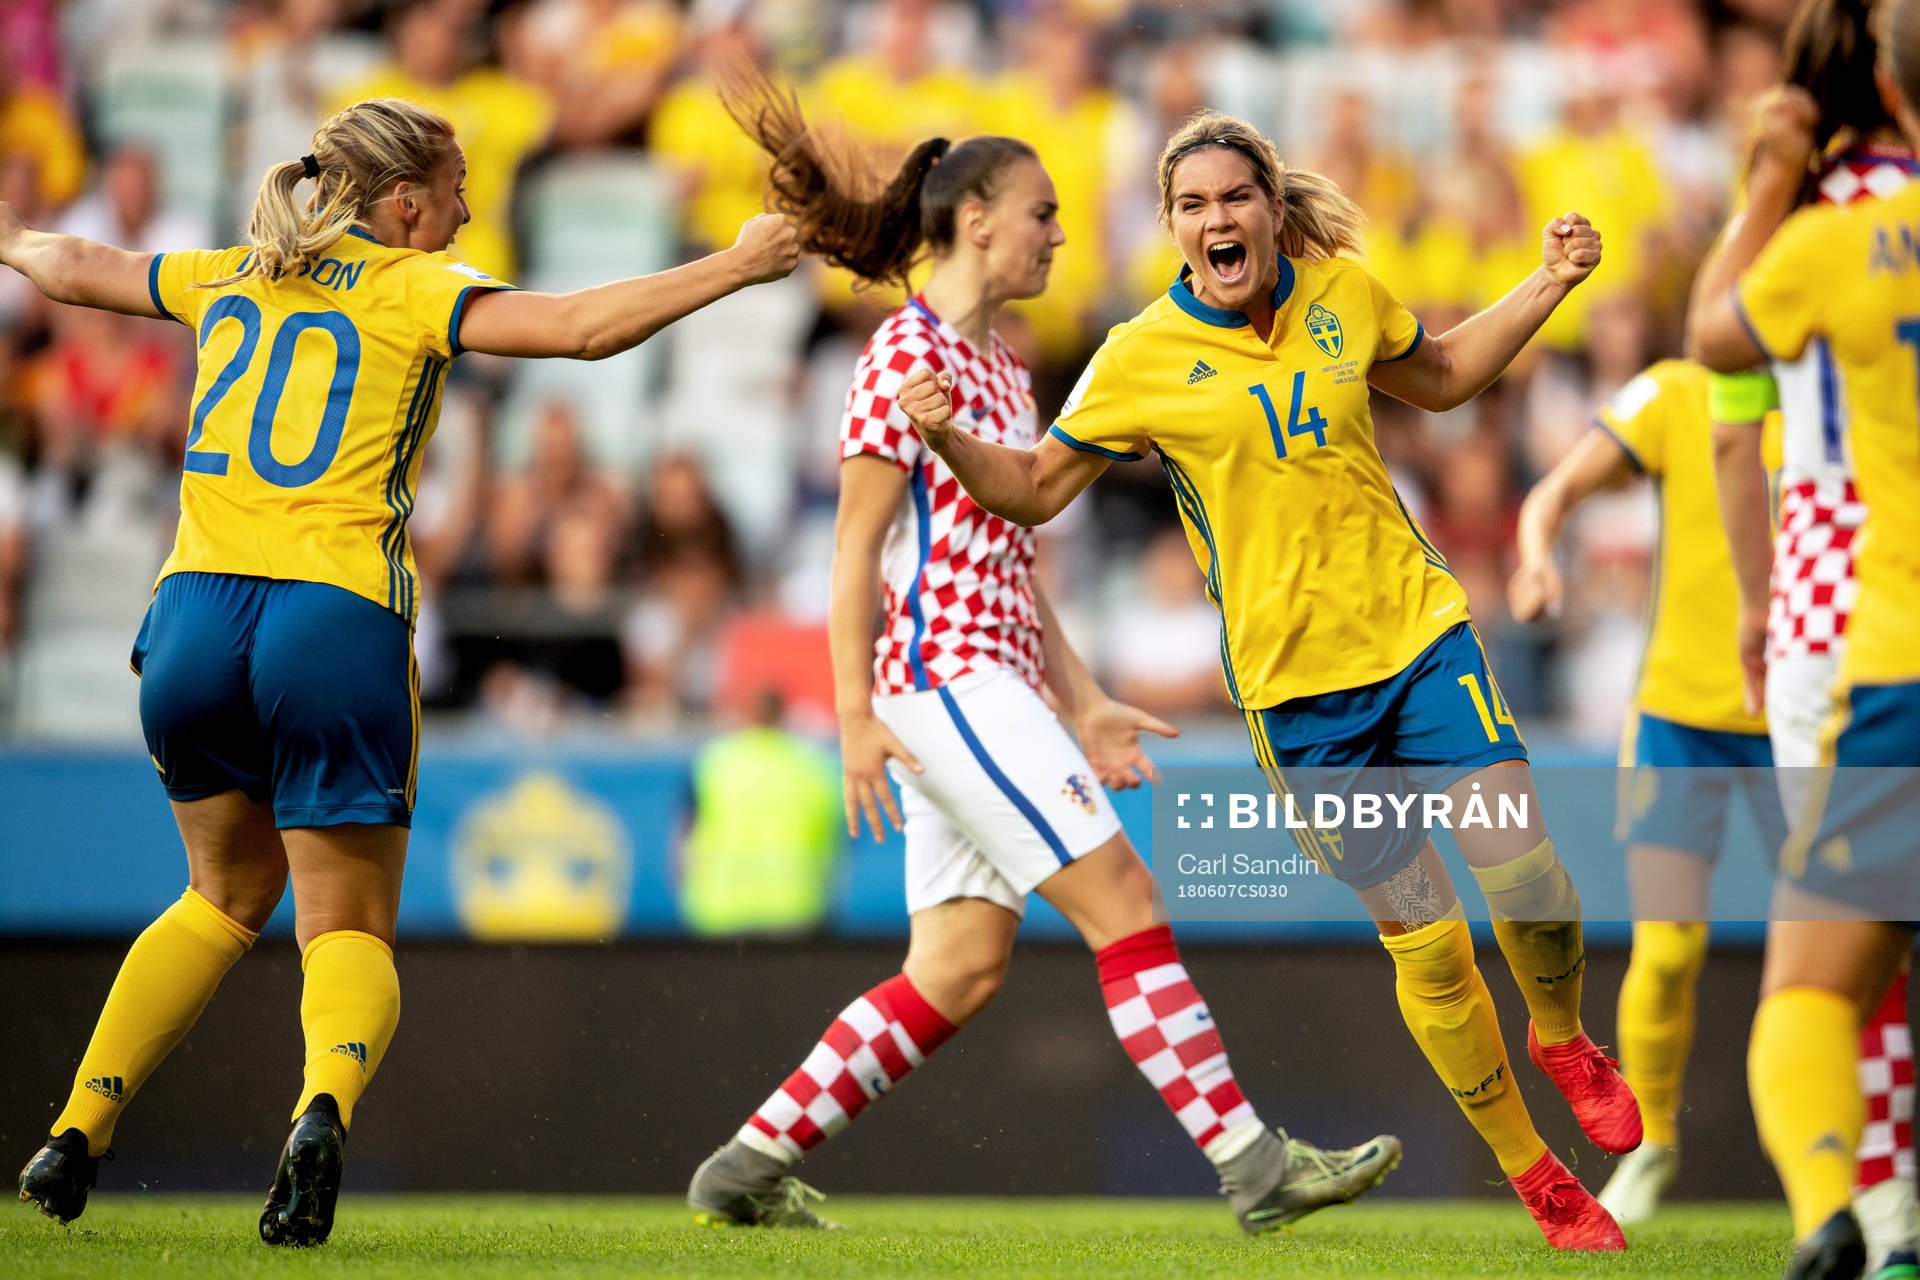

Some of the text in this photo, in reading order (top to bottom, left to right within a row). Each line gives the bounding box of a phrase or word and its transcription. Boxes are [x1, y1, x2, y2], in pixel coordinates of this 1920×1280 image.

[184, 295, 361, 488] 20
[1187, 369, 1218, 385] adidas
[1248, 371, 1328, 459] 14
[1457, 673, 1515, 743] 14
